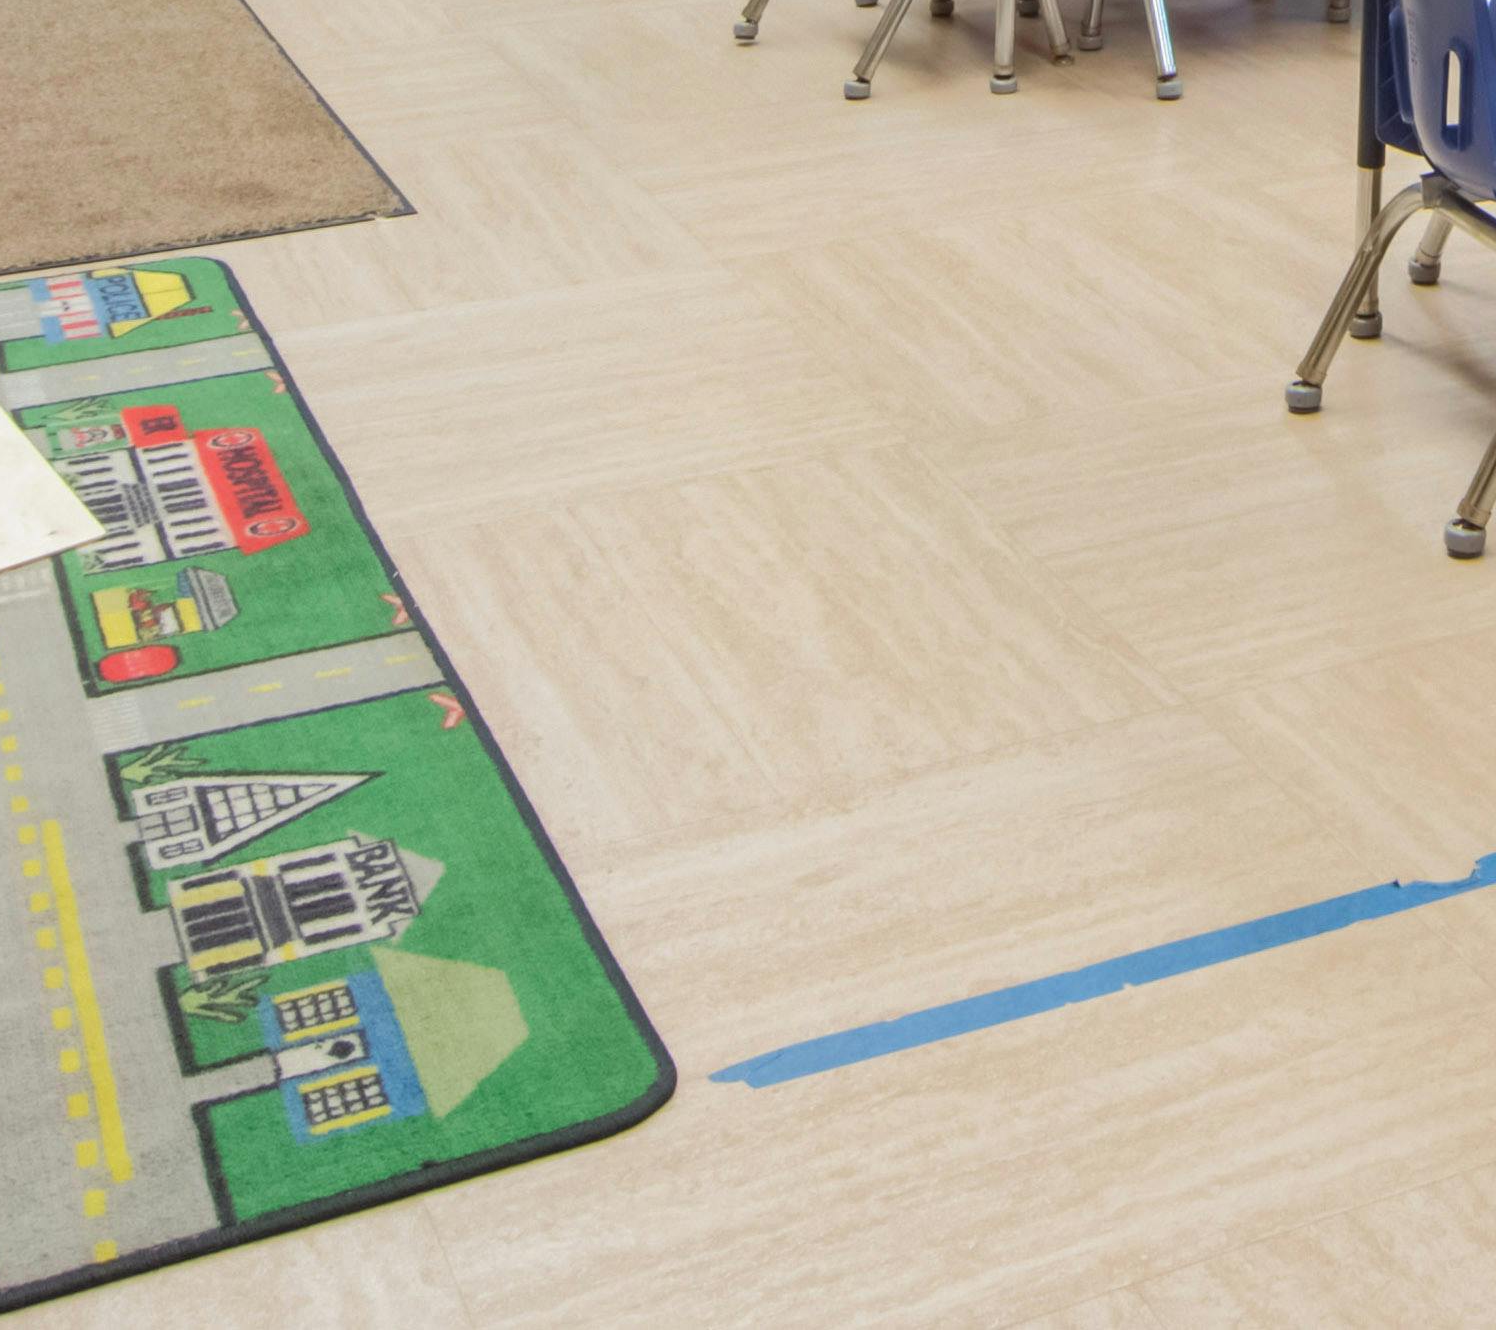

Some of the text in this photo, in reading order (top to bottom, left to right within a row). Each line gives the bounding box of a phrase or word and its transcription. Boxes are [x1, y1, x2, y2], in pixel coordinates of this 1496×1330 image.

[99, 276, 141, 323] POLICE
[139, 415, 179, 436] ER
[217, 445, 283, 519] HOSPITAL
[345, 843, 415, 926] BANK
